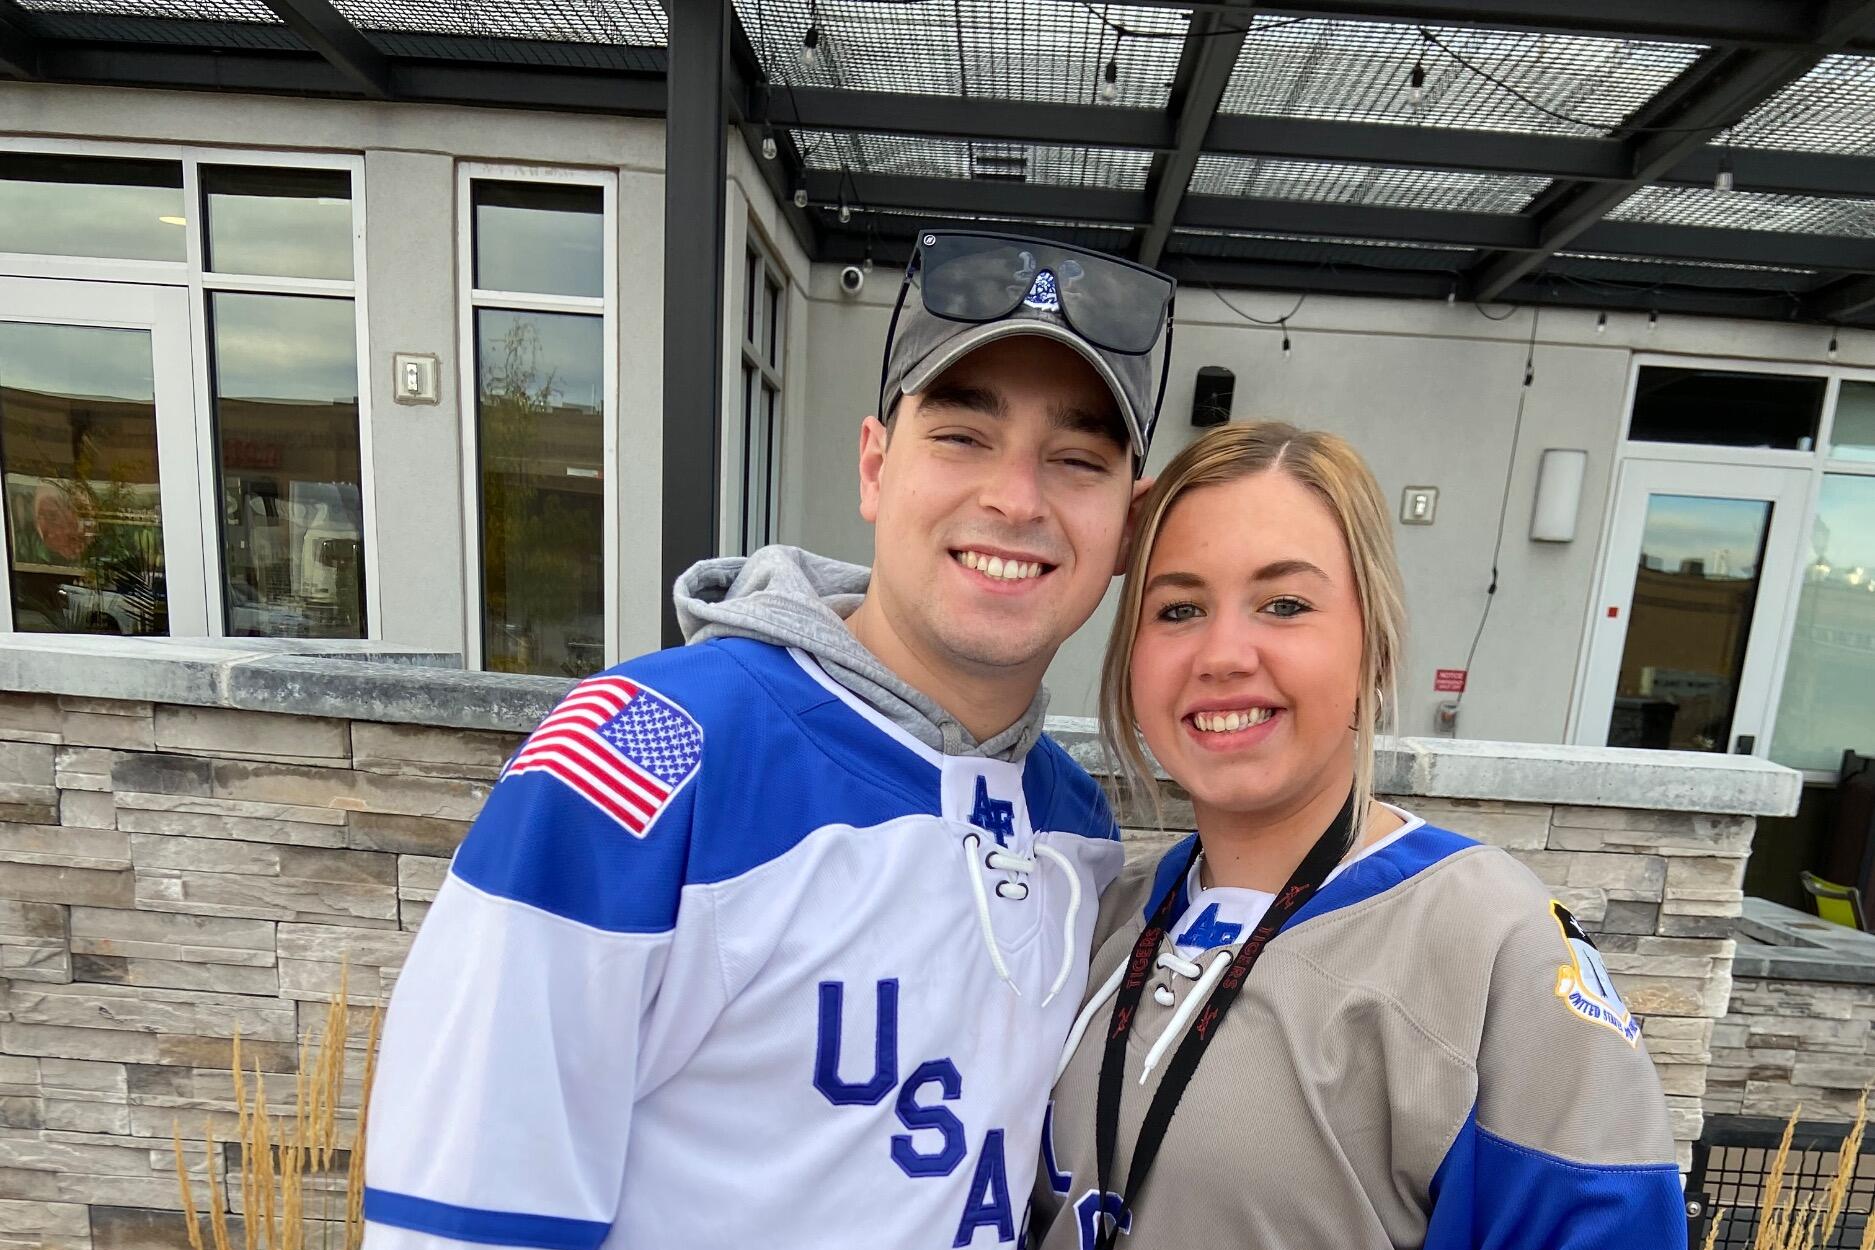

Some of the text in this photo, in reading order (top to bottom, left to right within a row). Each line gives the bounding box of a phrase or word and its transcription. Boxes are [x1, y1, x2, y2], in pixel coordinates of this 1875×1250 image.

[966, 774, 1015, 849] AF
[1125, 927, 1163, 990] TIGERS
[1222, 927, 1275, 989] TIGERS
[1568, 992, 1601, 1018] UNITED
